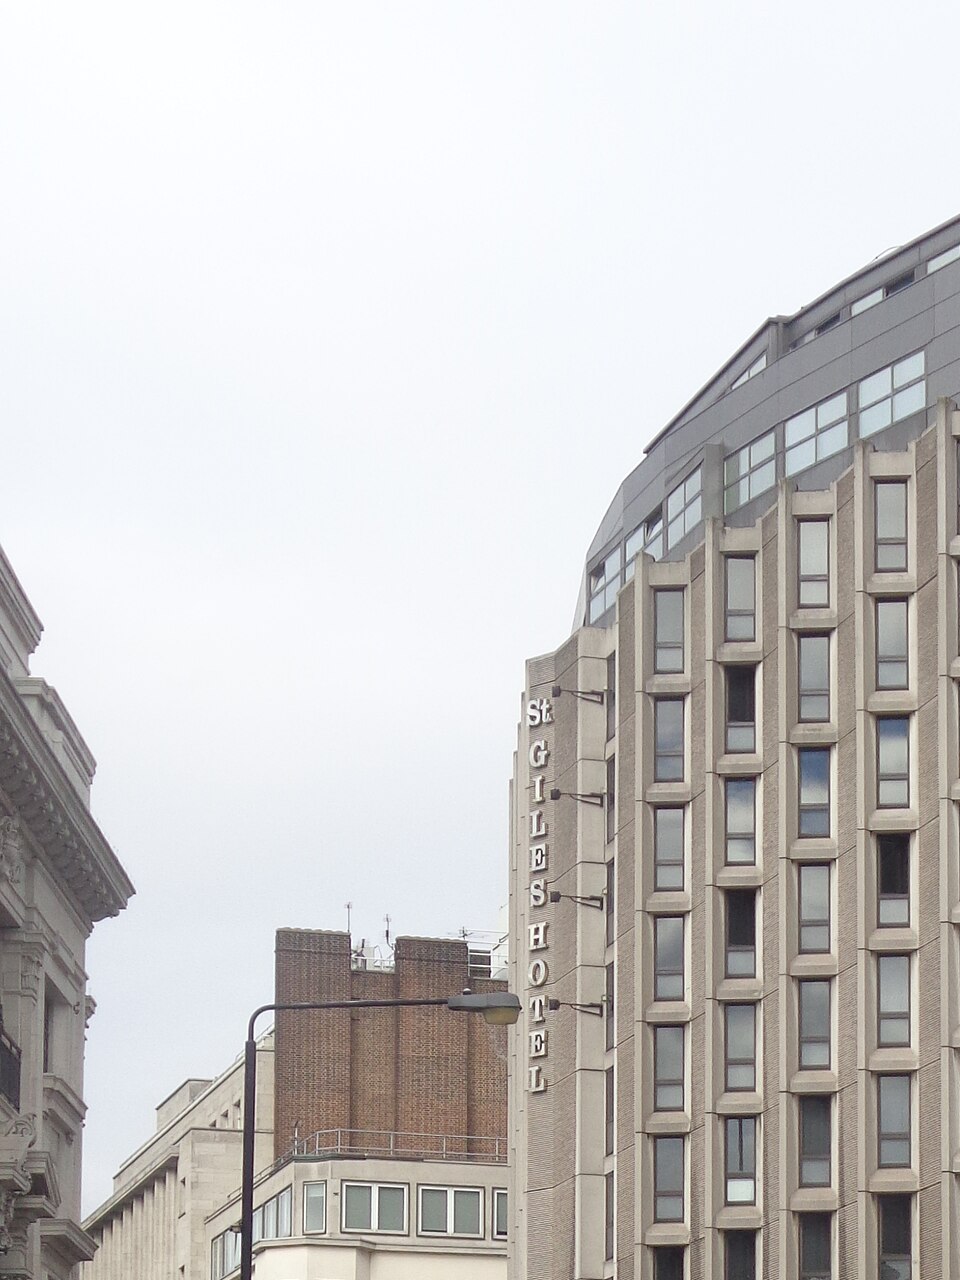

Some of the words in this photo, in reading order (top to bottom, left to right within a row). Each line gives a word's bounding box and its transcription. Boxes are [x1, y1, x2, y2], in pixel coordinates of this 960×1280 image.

[527, 698, 552, 727] St
[529, 739, 550, 908] GILES
[528, 921, 549, 1094] HOTEL
